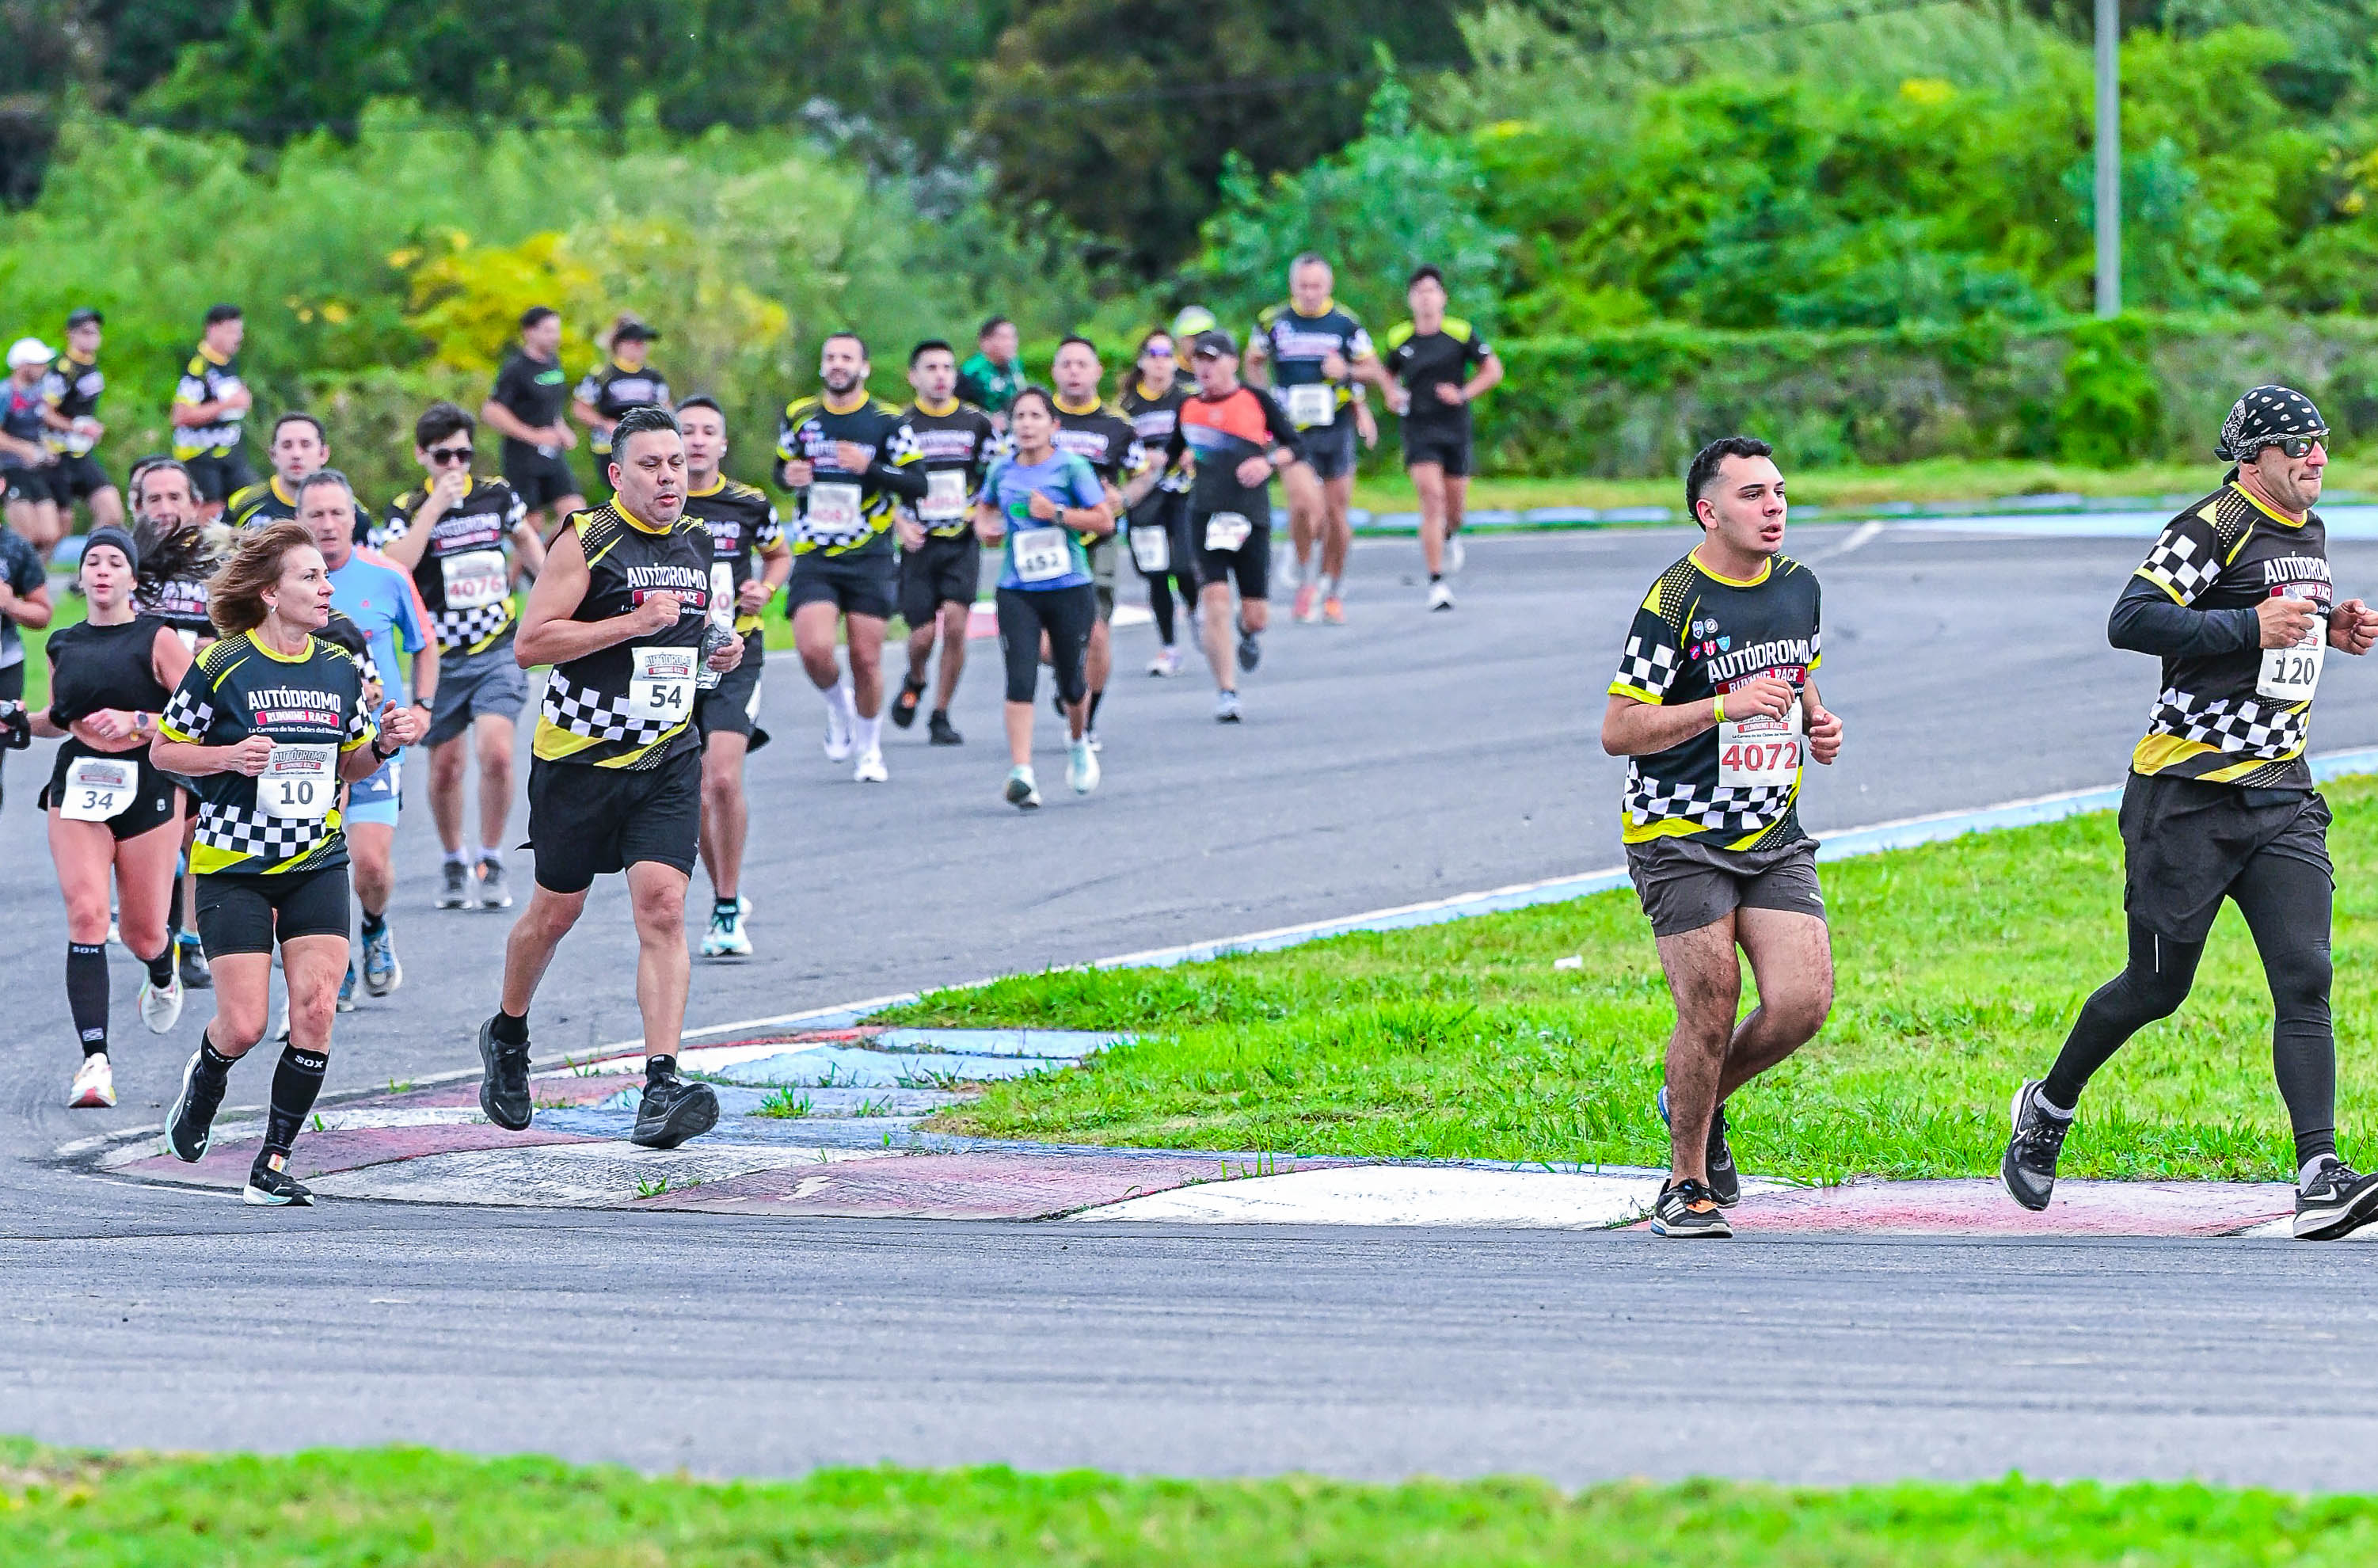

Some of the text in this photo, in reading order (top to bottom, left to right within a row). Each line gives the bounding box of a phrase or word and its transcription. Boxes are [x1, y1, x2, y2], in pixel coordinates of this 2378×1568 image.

[626, 562, 708, 591] AUTÓDROMO
[2263, 550, 2332, 584] AUTÓDROM
[449, 577, 502, 597] 4076
[2282, 584, 2315, 597] NNING
[1706, 639, 1810, 684] AUTÓDROMO
[2271, 657, 2315, 685] 120
[1774, 668, 1800, 682] RACE
[247, 685, 341, 713] AUTÓDROMO
[649, 684, 682, 709] 54
[265, 710, 332, 725] RUNNING RACE
[272, 748, 328, 763] AUTÓDROMO
[1722, 742, 1797, 771] 4072
[82, 790, 113, 809] 34
[280, 780, 314, 805] 10
[295, 1055, 324, 1068] SOX
